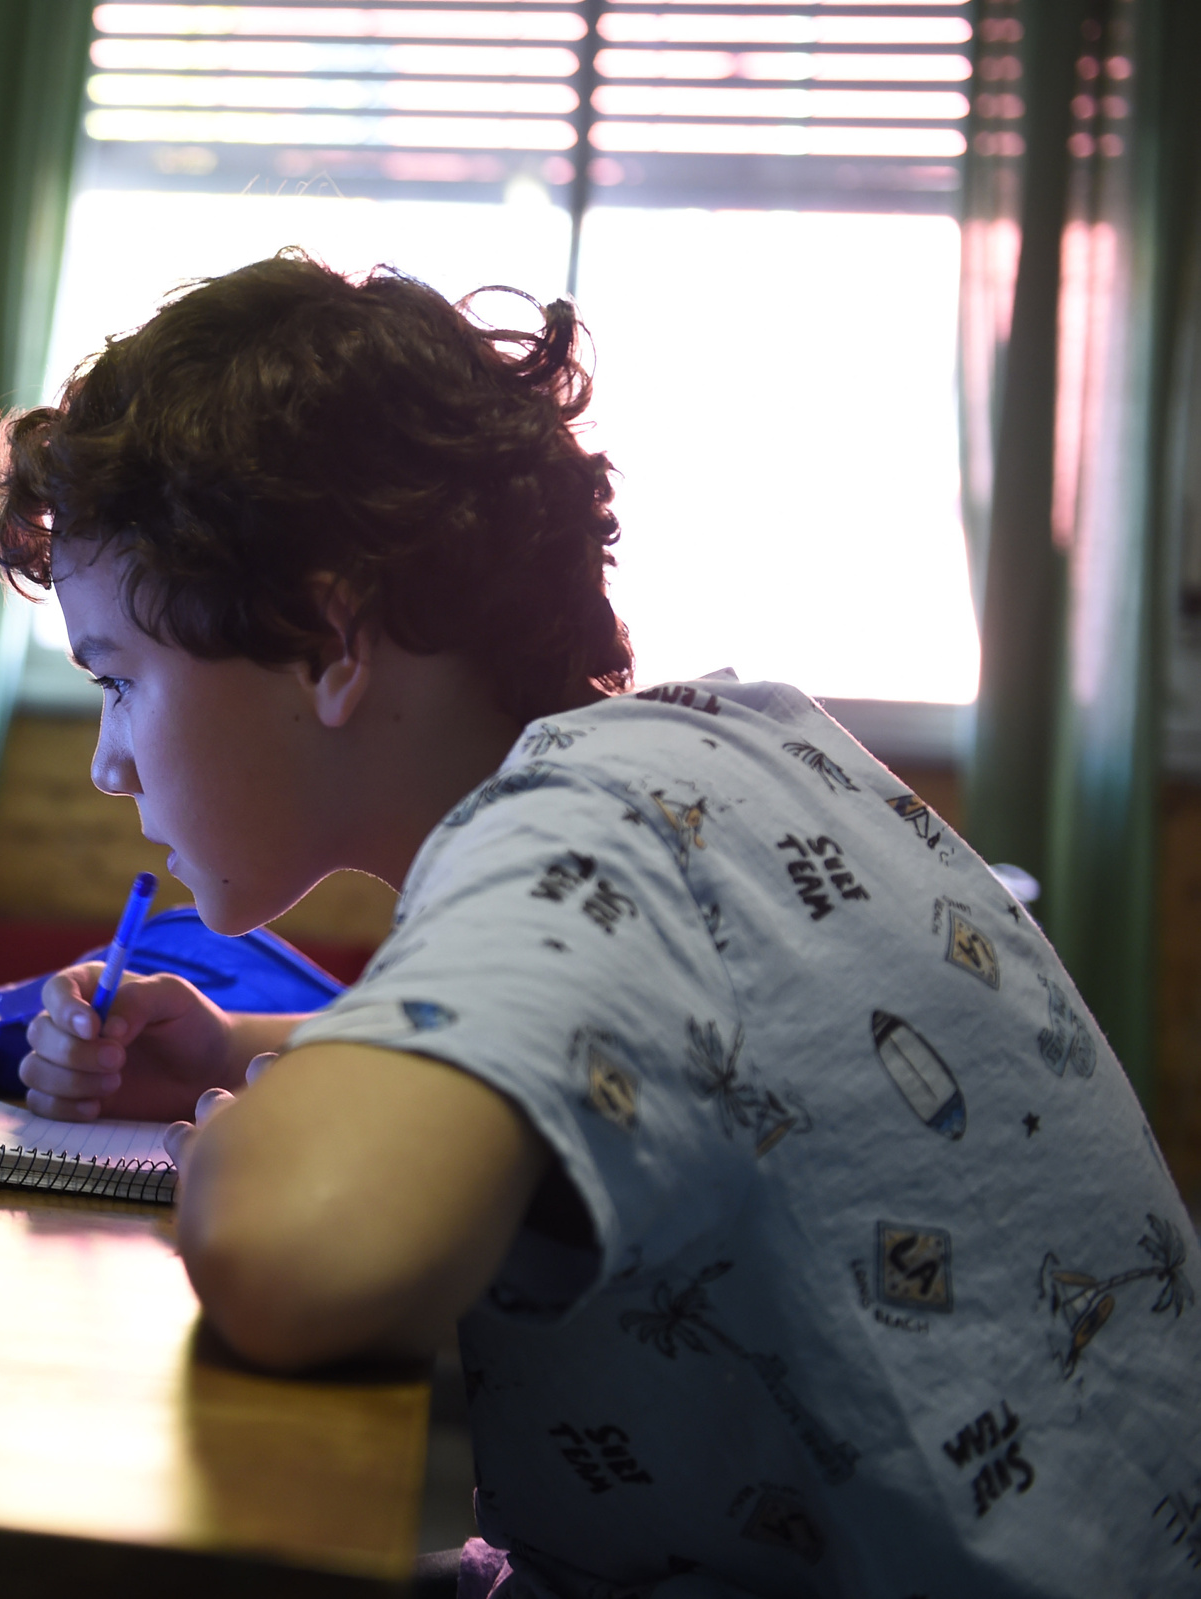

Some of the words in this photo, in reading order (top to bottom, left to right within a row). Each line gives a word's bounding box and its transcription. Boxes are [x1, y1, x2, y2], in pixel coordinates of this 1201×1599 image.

[776, 833, 835, 922] TEAM
[805, 835, 871, 901] SURF
[873, 1309, 930, 1335] BEACH
[548, 1422, 614, 1494] TEAM
[583, 1424, 654, 1486] SURF
